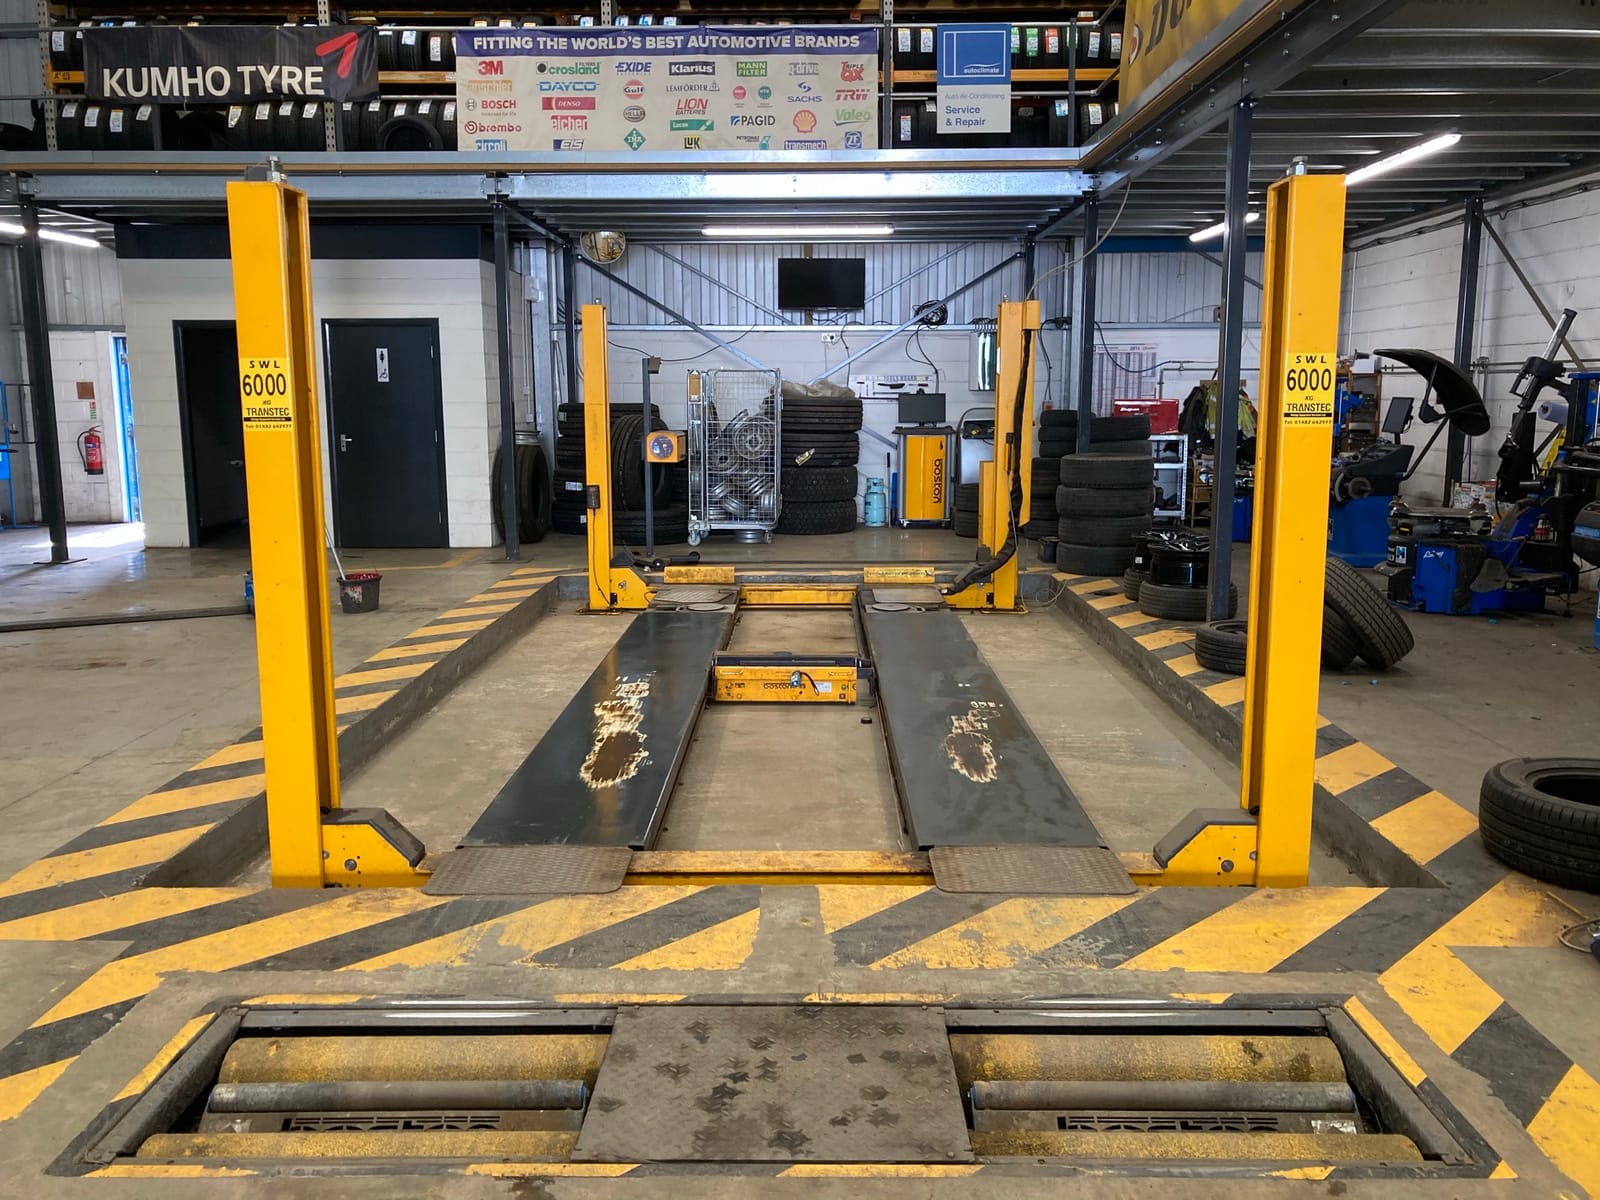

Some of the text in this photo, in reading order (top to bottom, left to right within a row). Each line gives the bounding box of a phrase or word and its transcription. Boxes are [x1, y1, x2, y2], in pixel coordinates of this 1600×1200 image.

[473, 35, 860, 50] FITTING THE WORLD'S BEST AUTOMOTIVE BRANDS
[478, 60, 504, 75] 3M
[549, 63, 600, 75] crosland
[616, 62, 652, 73] EXIDE
[671, 64, 713, 74] Klarius
[103, 65, 325, 97] KUMHO TYRE
[536, 81, 600, 91] DAYCO
[835, 89, 870, 101] TRW
[481, 100, 516, 109] BOSCH
[677, 98, 708, 110] LION
[945, 105, 981, 114] Service
[741, 115, 776, 126] PAGID
[835, 109, 872, 121] Valeo
[478, 122, 522, 132] brembo
[945, 118, 986, 128] & Repair
[242, 373, 287, 396] 6000
[1286, 368, 1332, 391] 6000
[246, 407, 290, 416] TRANSTEC
[1287, 403, 1331, 411] TRANSTEC
[933, 458, 943, 504] boston
